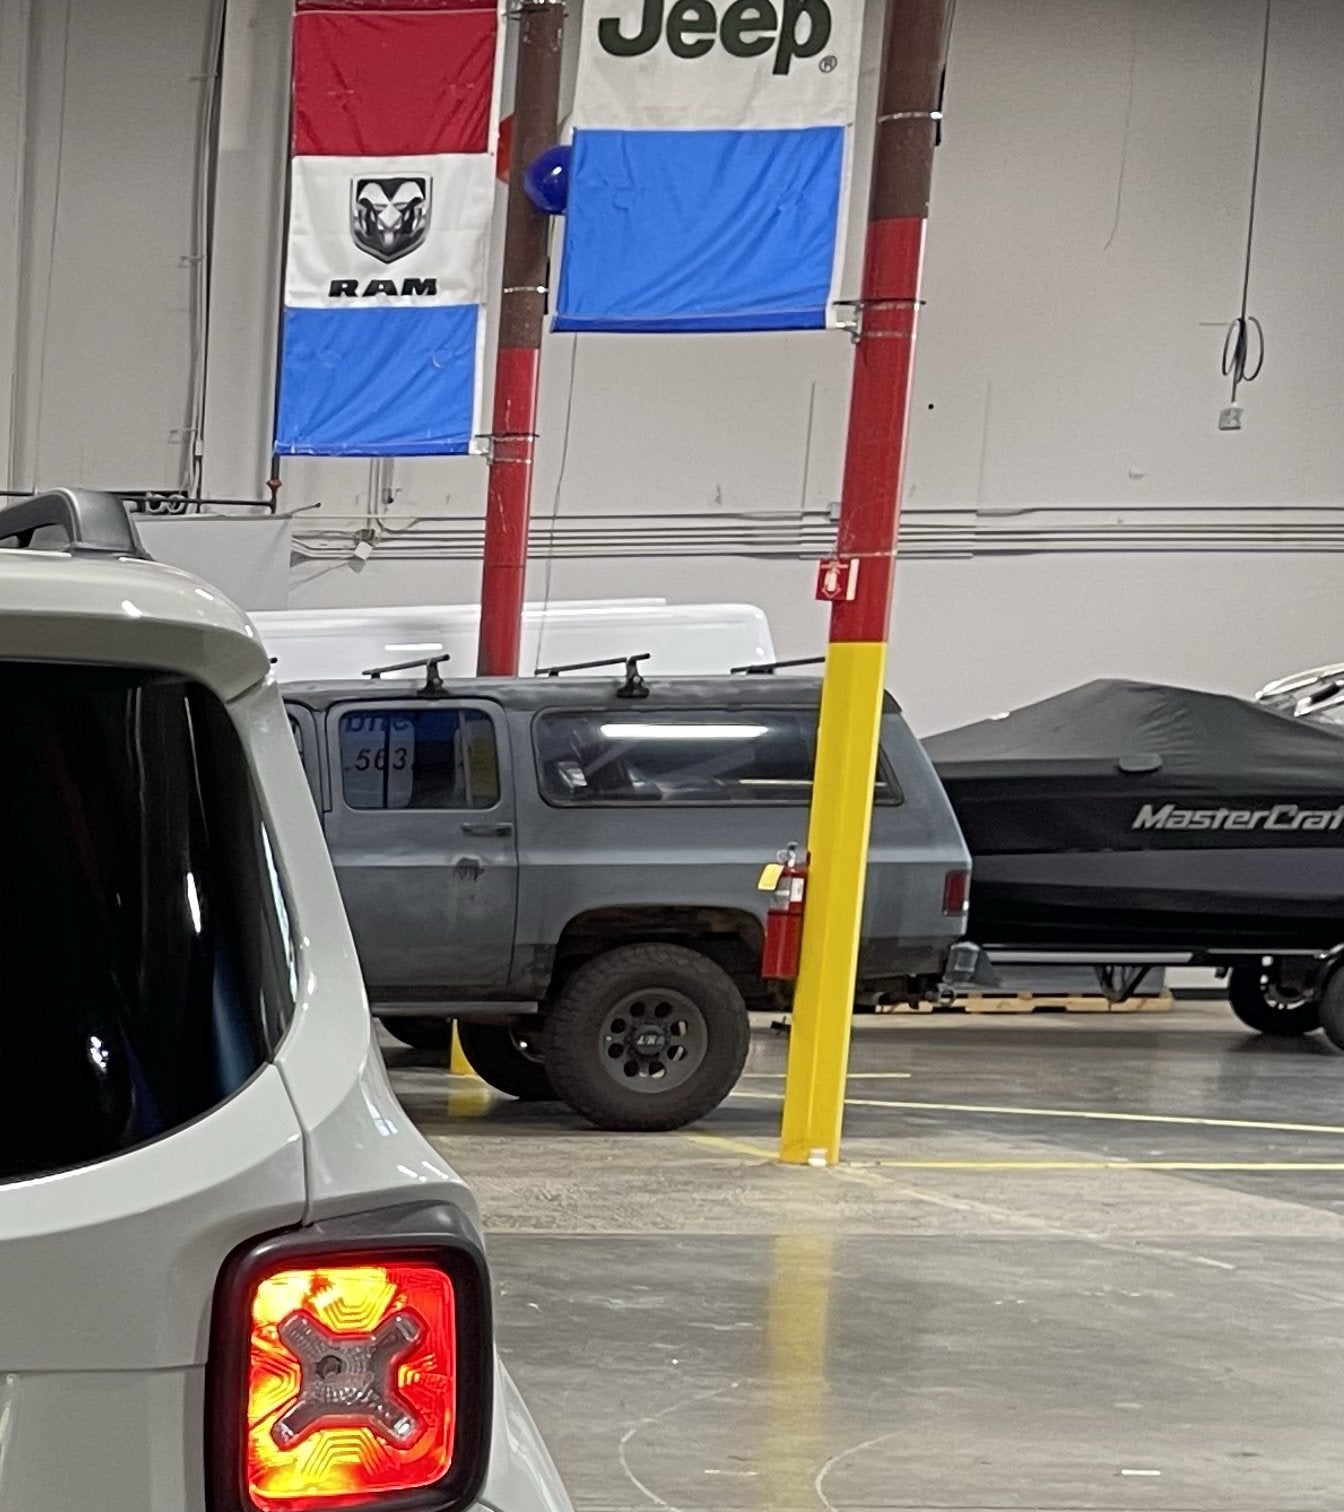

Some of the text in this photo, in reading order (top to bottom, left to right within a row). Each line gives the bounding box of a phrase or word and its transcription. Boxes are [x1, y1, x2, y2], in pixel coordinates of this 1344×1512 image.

[598, 0, 831, 76] Jeep
[328, 277, 437, 297] RAM
[1131, 804, 1344, 831] MasterCraf
